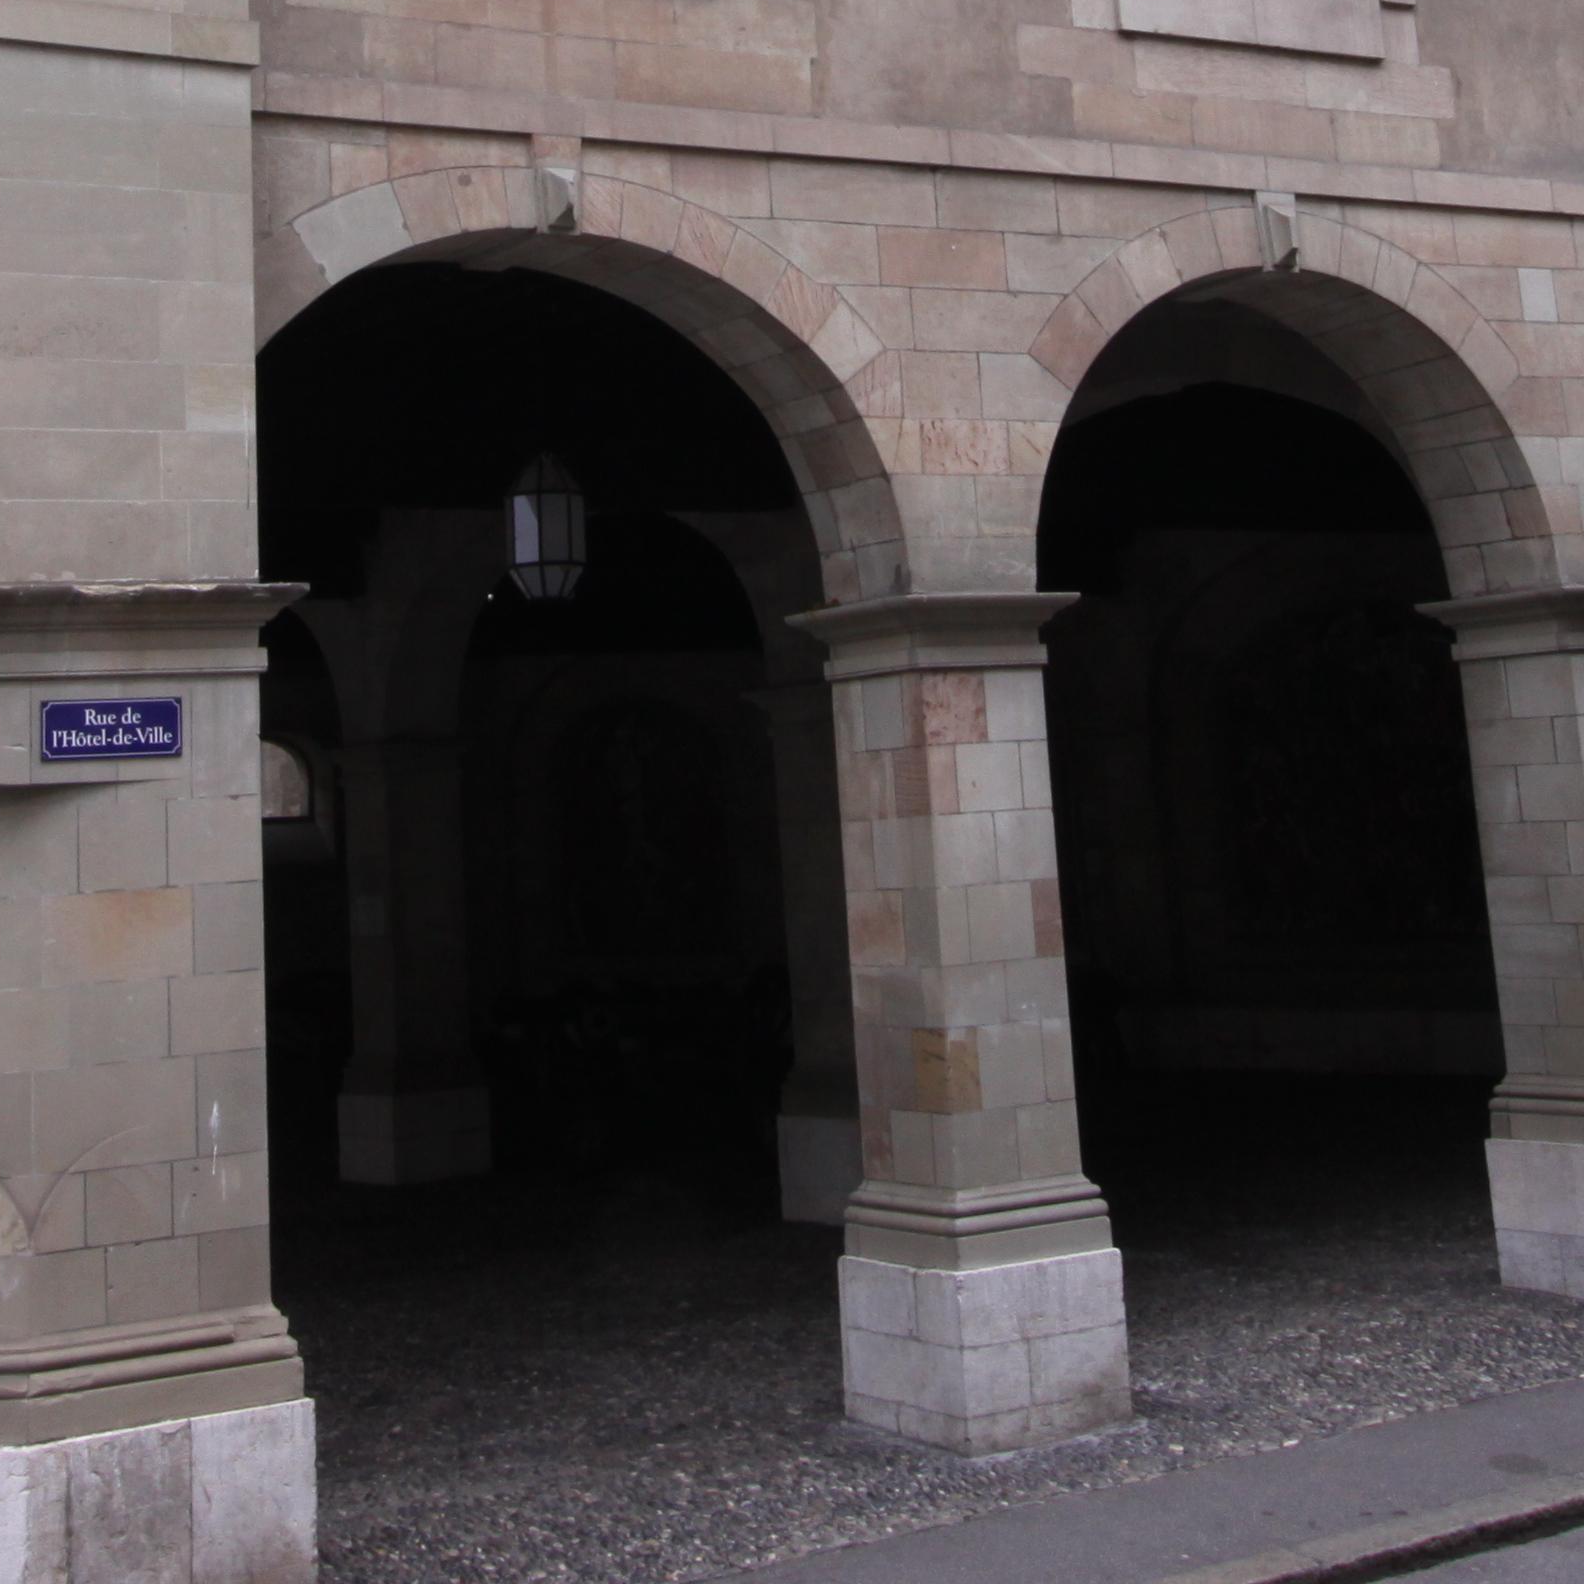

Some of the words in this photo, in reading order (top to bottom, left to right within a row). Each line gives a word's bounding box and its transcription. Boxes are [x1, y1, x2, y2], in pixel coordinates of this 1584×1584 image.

[84, 708, 117, 726] Rue
[121, 706, 142, 725] de
[52, 726, 173, 748] l'Hôtel-de-Ville
